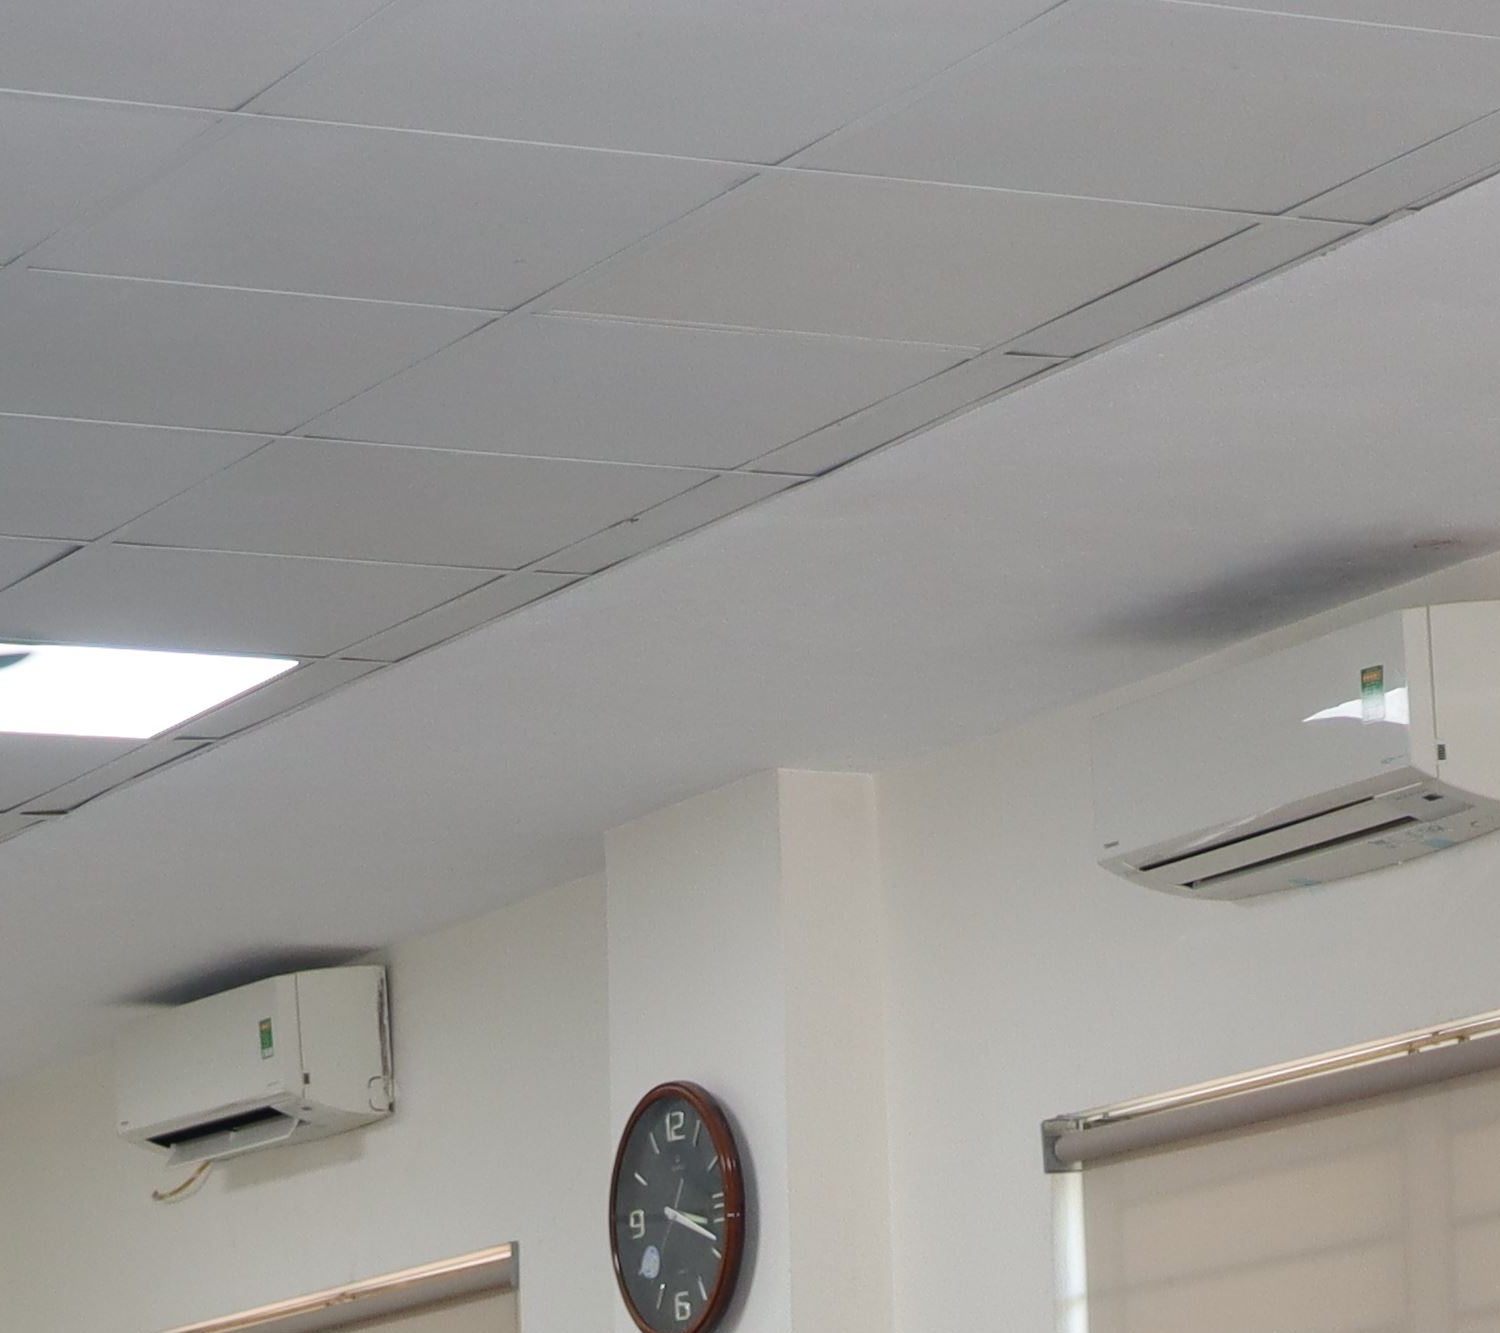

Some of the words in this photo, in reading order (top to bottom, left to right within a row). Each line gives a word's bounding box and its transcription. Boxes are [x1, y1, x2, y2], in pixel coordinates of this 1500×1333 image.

[665, 1111, 686, 1142] 12
[629, 1209, 646, 1239] 9
[675, 1291, 691, 1321] 6
